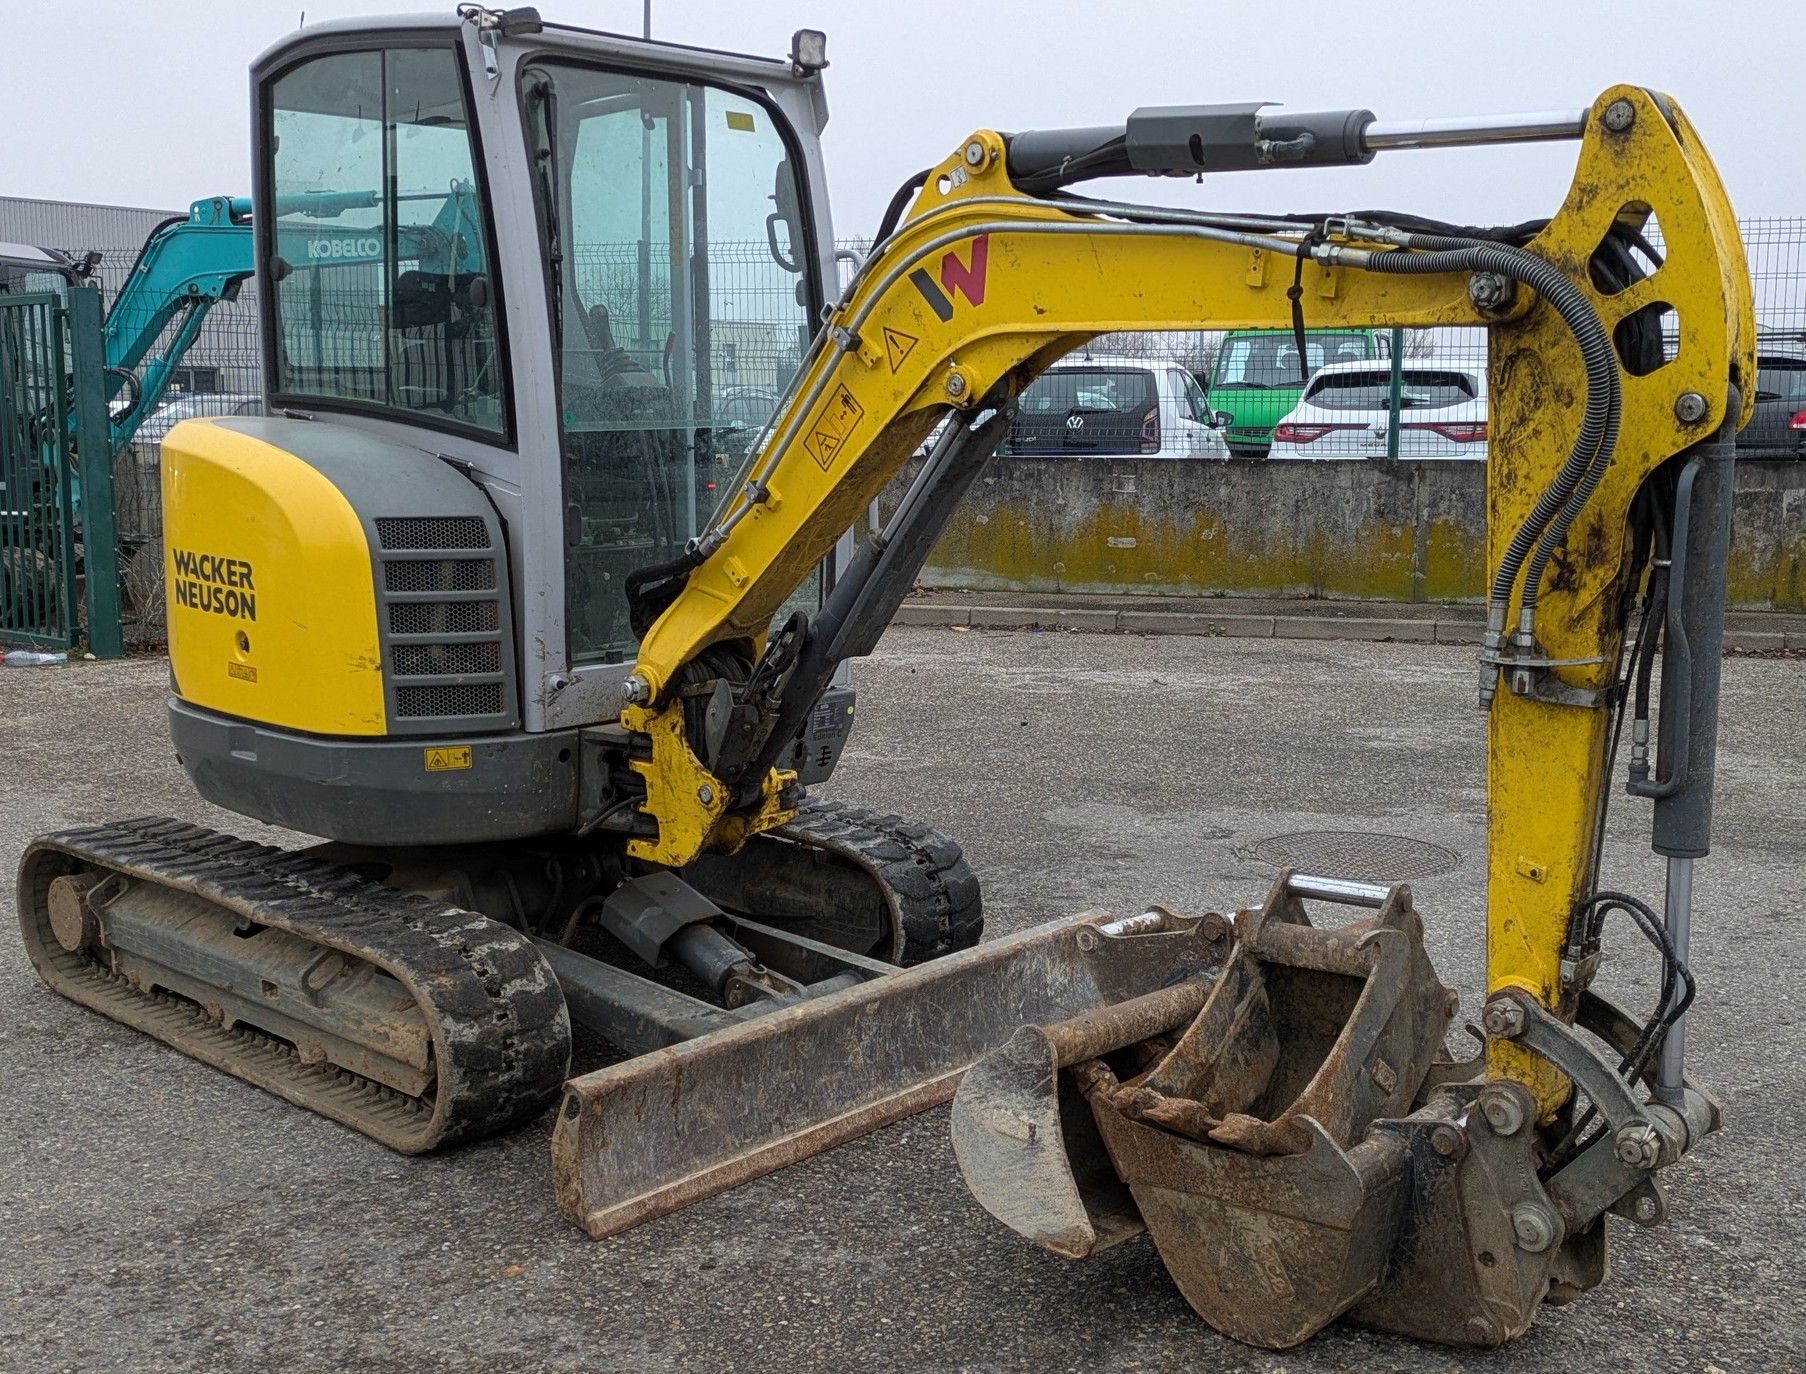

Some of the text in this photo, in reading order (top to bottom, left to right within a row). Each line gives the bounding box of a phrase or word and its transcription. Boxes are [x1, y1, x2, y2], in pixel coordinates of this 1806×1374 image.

[307, 238, 381, 258] KOBELCO
[172, 548, 255, 590] WACKER
[175, 578, 256, 622] NEUSON
